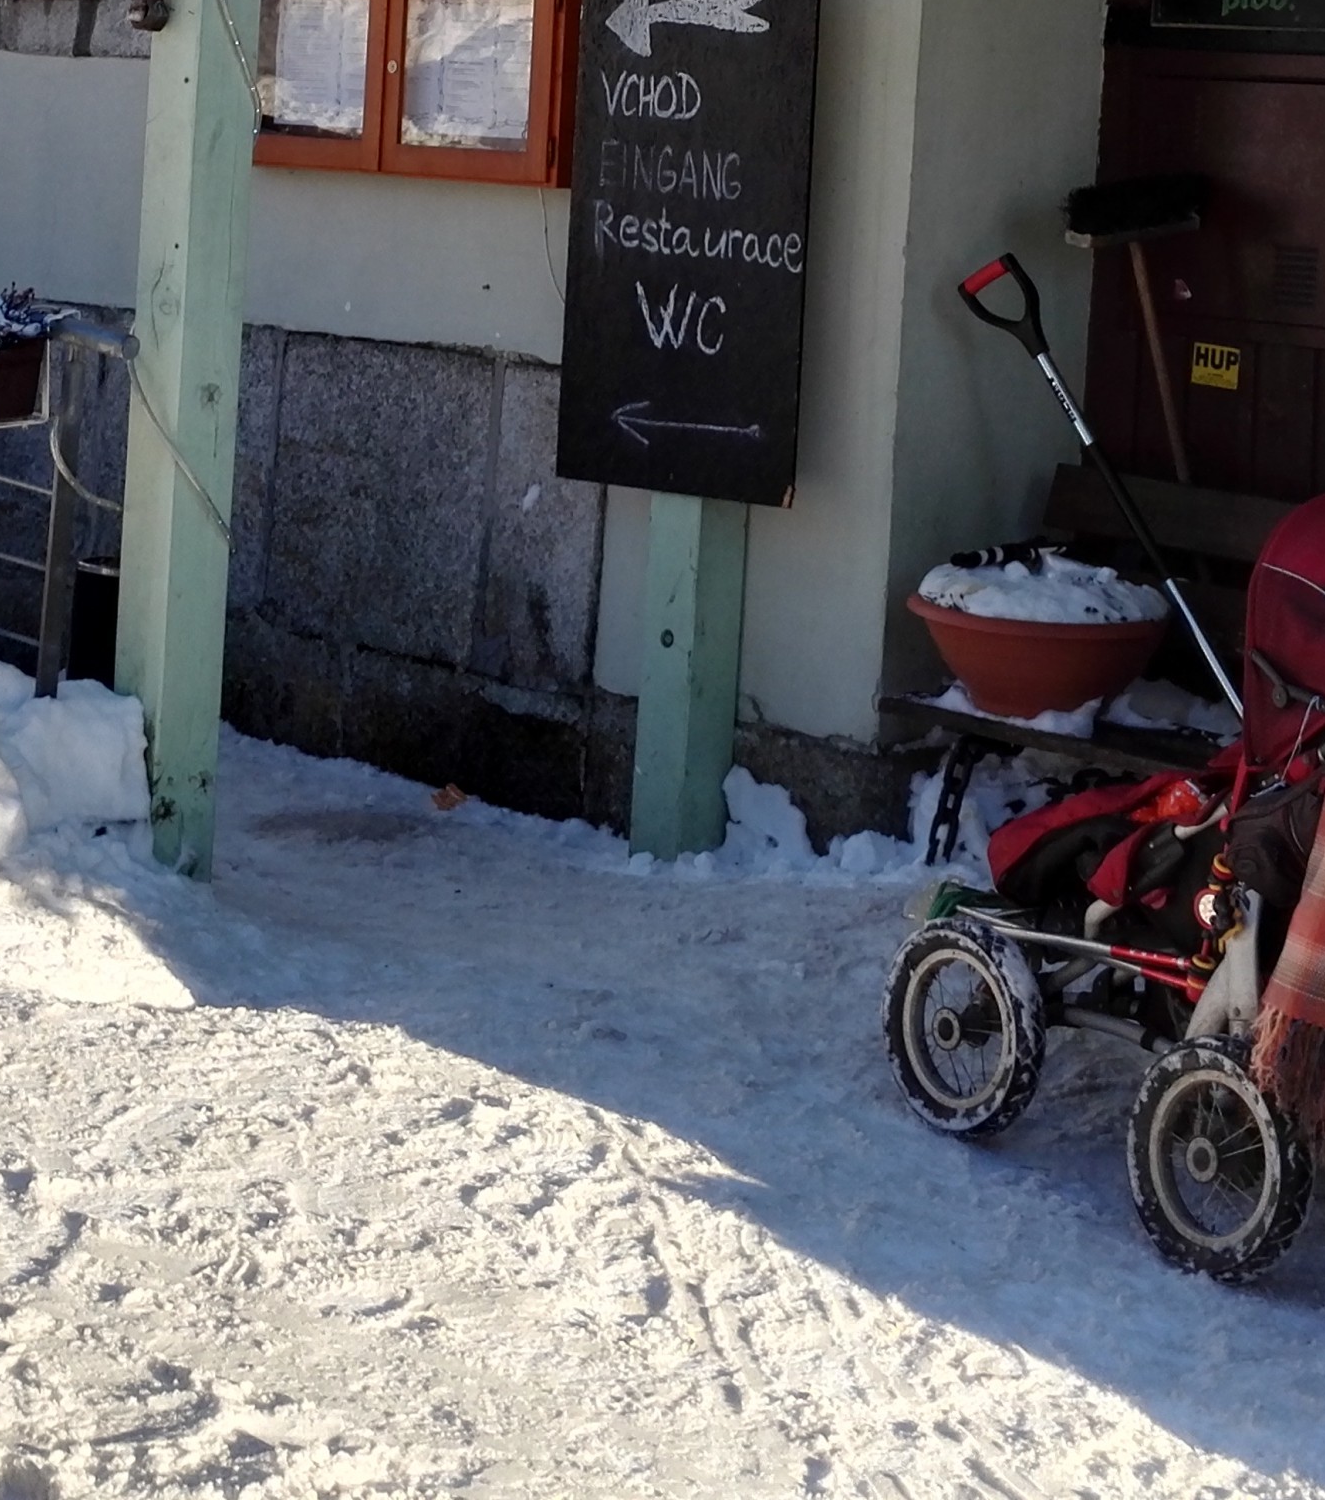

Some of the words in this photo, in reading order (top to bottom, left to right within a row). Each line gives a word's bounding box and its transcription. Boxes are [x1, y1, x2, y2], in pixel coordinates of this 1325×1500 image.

[600, 70, 701, 120] VCHOD
[599, 139, 742, 201] EINGANG
[594, 200, 804, 273] Restaurace
[636, 281, 727, 355] WC
[1195, 346, 1239, 371] HUP
